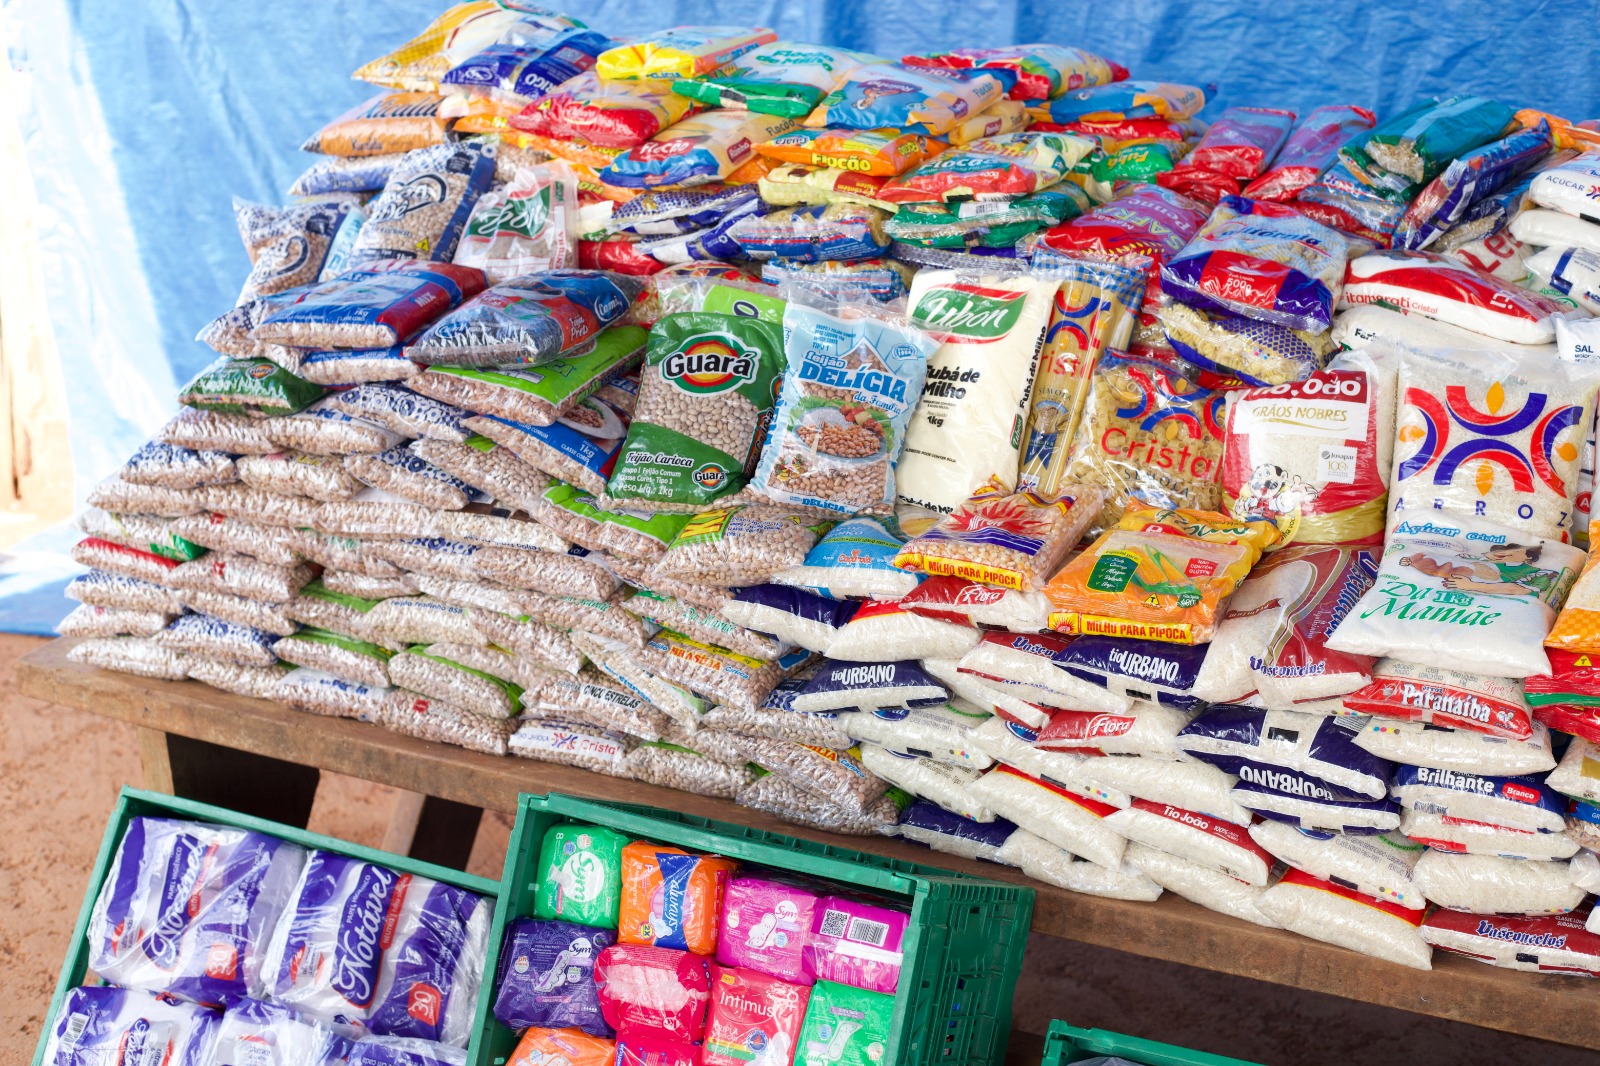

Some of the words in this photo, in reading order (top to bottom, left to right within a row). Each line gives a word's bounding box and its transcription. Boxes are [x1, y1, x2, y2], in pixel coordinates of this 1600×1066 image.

[811, 152, 872, 172] Flocão
[1031, 325, 1047, 360] Milho
[1575, 344, 1594, 354] SAL
[665, 351, 753, 378] Guará
[806, 351, 846, 368] feijão
[1039, 350, 1097, 381] ristal
[959, 368, 981, 384] de
[1029, 361, 1039, 379] de
[798, 361, 907, 404] DELÍCIA
[922, 381, 967, 400] Milho
[853, 391, 867, 403] da
[869, 393, 903, 416] Família
[1019, 377, 1034, 410] Fubá
[927, 416, 945, 428] 1kg
[1252, 403, 1292, 418] GRÃOS
[1295, 407, 1348, 423] NOBRES
[579, 443, 596, 459] 1kg
[626, 451, 654, 466] Feijão
[654, 453, 694, 468] Carioca
[1101, 427, 1220, 483] Cristal
[1330, 452, 1355, 461] Josapar
[642, 467, 659, 476] Feijão
[659, 469, 682, 478] Comum
[655, 477, 668, 485] Tipo
[694, 471, 729, 482] Guará
[618, 483, 637, 493] Peso
[657, 485, 674, 498] 1kg
[802, 497, 847, 513] DELÍCIA
[924, 501, 937, 512] de
[1466, 532, 1506, 545] Cristal
[928, 560, 955, 576] MILHO
[957, 566, 982, 579] PARA
[983, 571, 1018, 587] PIPOCA
[962, 584, 1001, 604] Flora
[1378, 581, 1434, 601] Da
[1360, 597, 1504, 628] Mamãe
[1086, 620, 1117, 635] MILHO
[1120, 624, 1147, 637] PARA
[1149, 626, 1187, 640] PIPOCA
[1249, 655, 1326, 678] Vasconcelos
[604, 690, 642, 709] ESTRELAS
[1401, 684, 1491, 724] Paranaíba
[1089, 716, 1131, 736] Flora
[580, 739, 621, 755] Cristal
[840, 758, 866, 779] Carioca
[1417, 767, 1495, 794] Brilhante
[1506, 786, 1535, 801] Branco
[1163, 805, 1180, 819] Tio
[1179, 813, 1209, 830] João
[570, 852, 596, 902] Sym
[668, 878, 682, 931] always
[776, 904, 799, 920] Sym
[337, 866, 393, 1001] Notável
[383, 916, 394, 945] NEUTRO
[1475, 919, 1568, 949] Vasconcelos
[569, 942, 592, 957] Sym
[209, 949, 228, 976] 30
[409, 990, 430, 1017] 30
[720, 990, 775, 1018] Intimus
